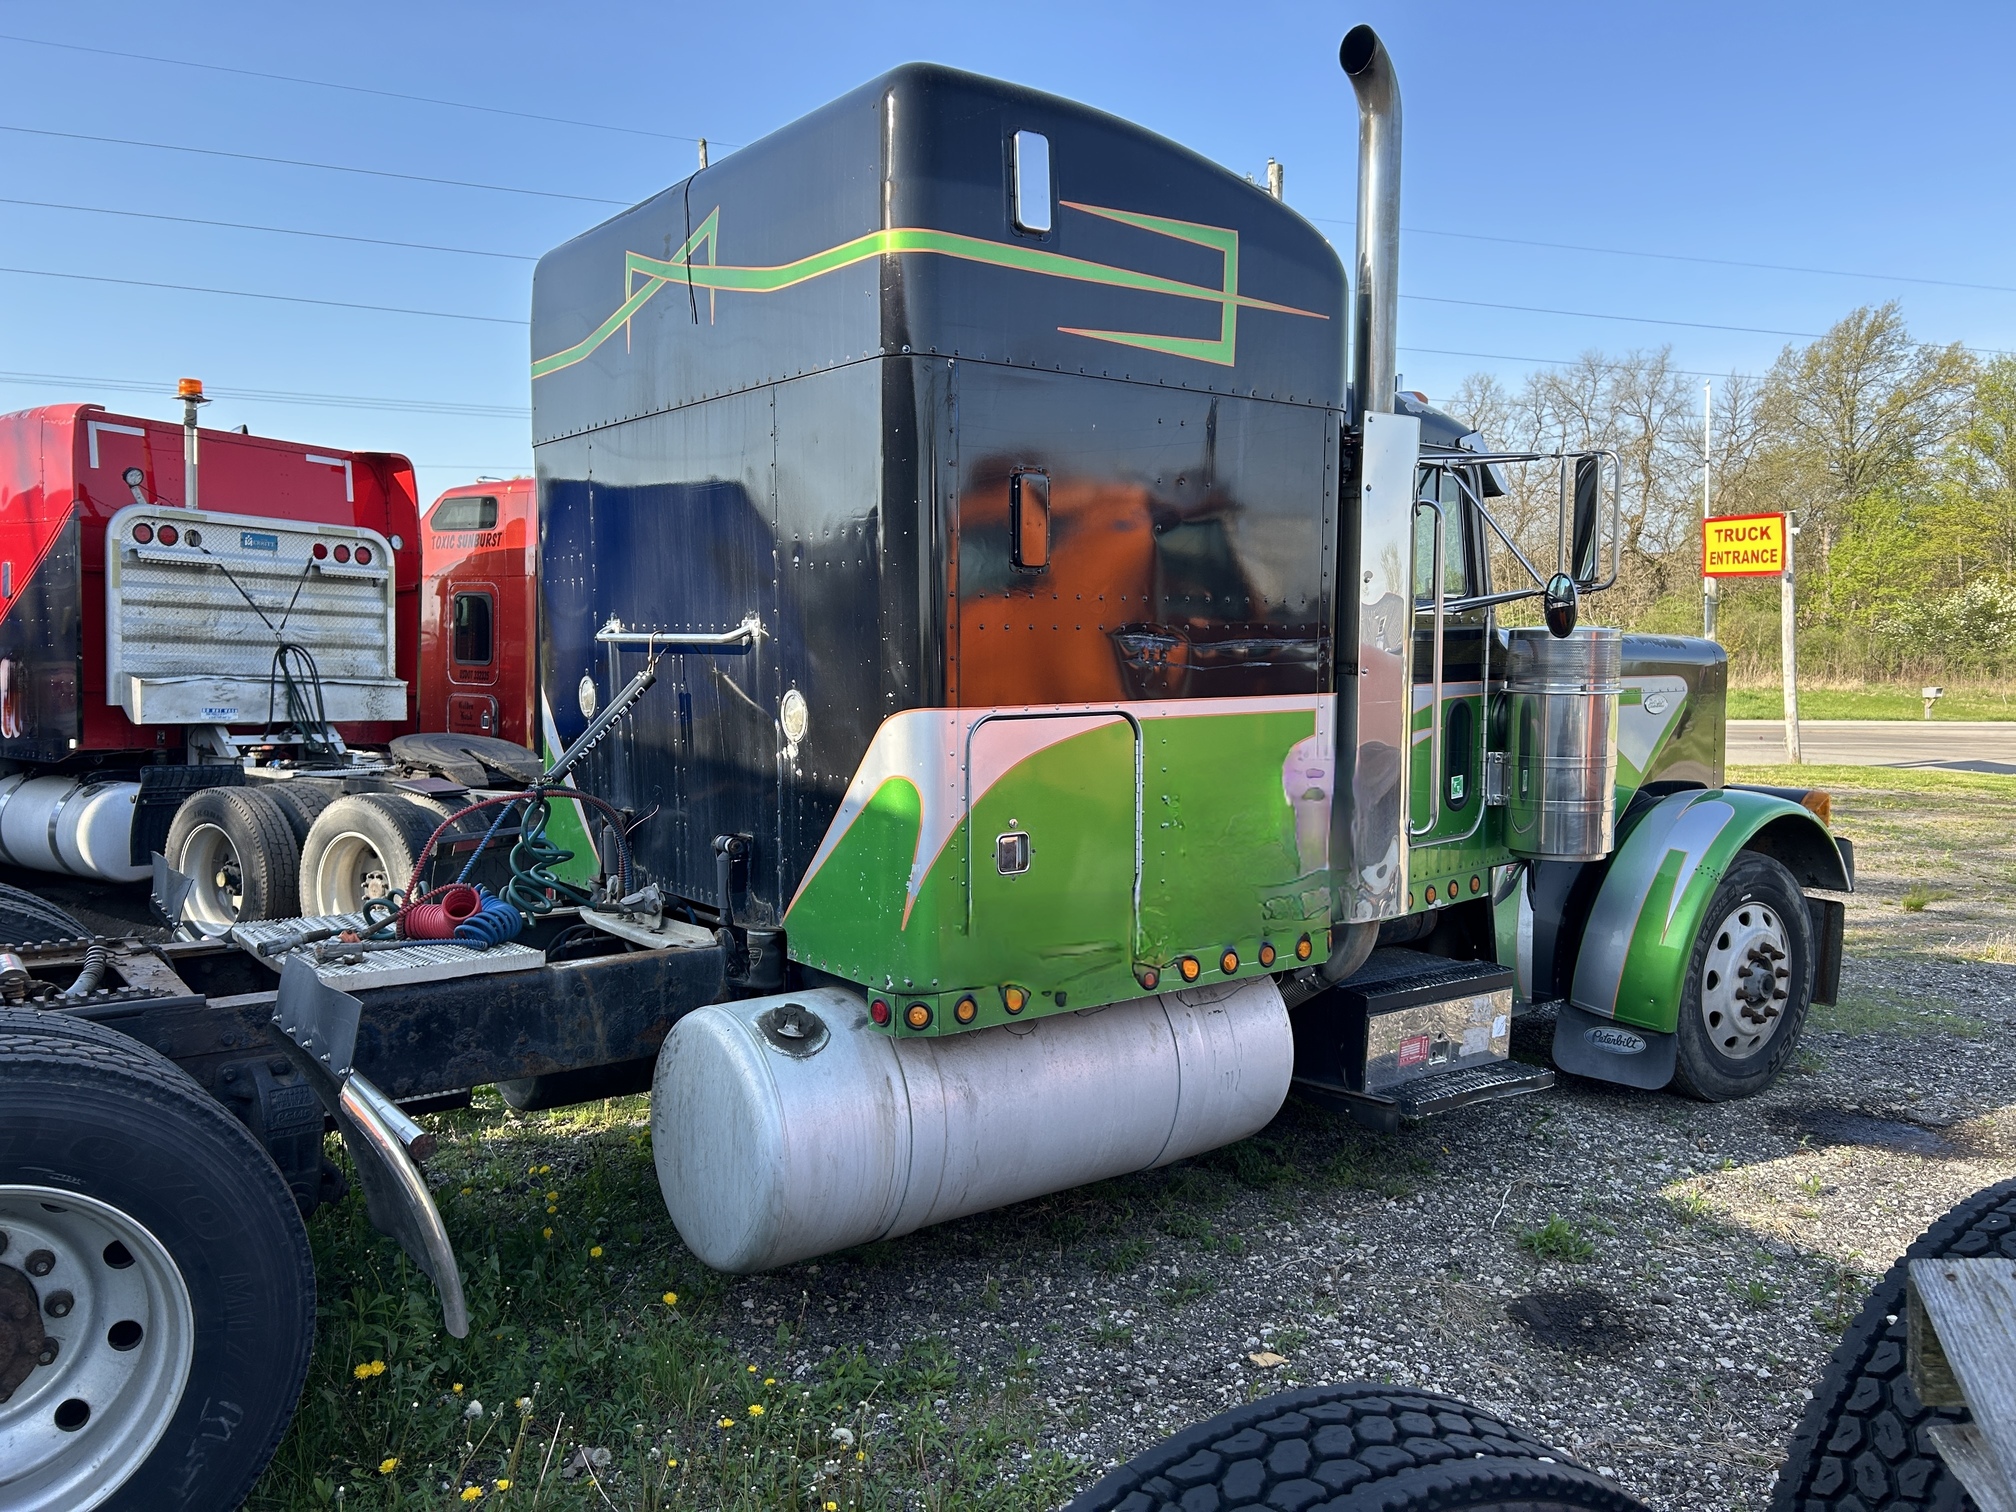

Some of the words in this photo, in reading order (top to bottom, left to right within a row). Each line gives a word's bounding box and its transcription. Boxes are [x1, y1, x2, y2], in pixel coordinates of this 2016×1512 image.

[431, 534, 455, 550] TOXIC
[456, 531, 503, 549] SUNBURST
[1714, 526, 1772, 543] TRUCK
[1709, 549, 1778, 565] ENTRANCE
[578, 700, 636, 760] TECTRAN
[1768, 950, 1811, 1075] OOPER
[1592, 1030, 1641, 1049] Peterbilt
